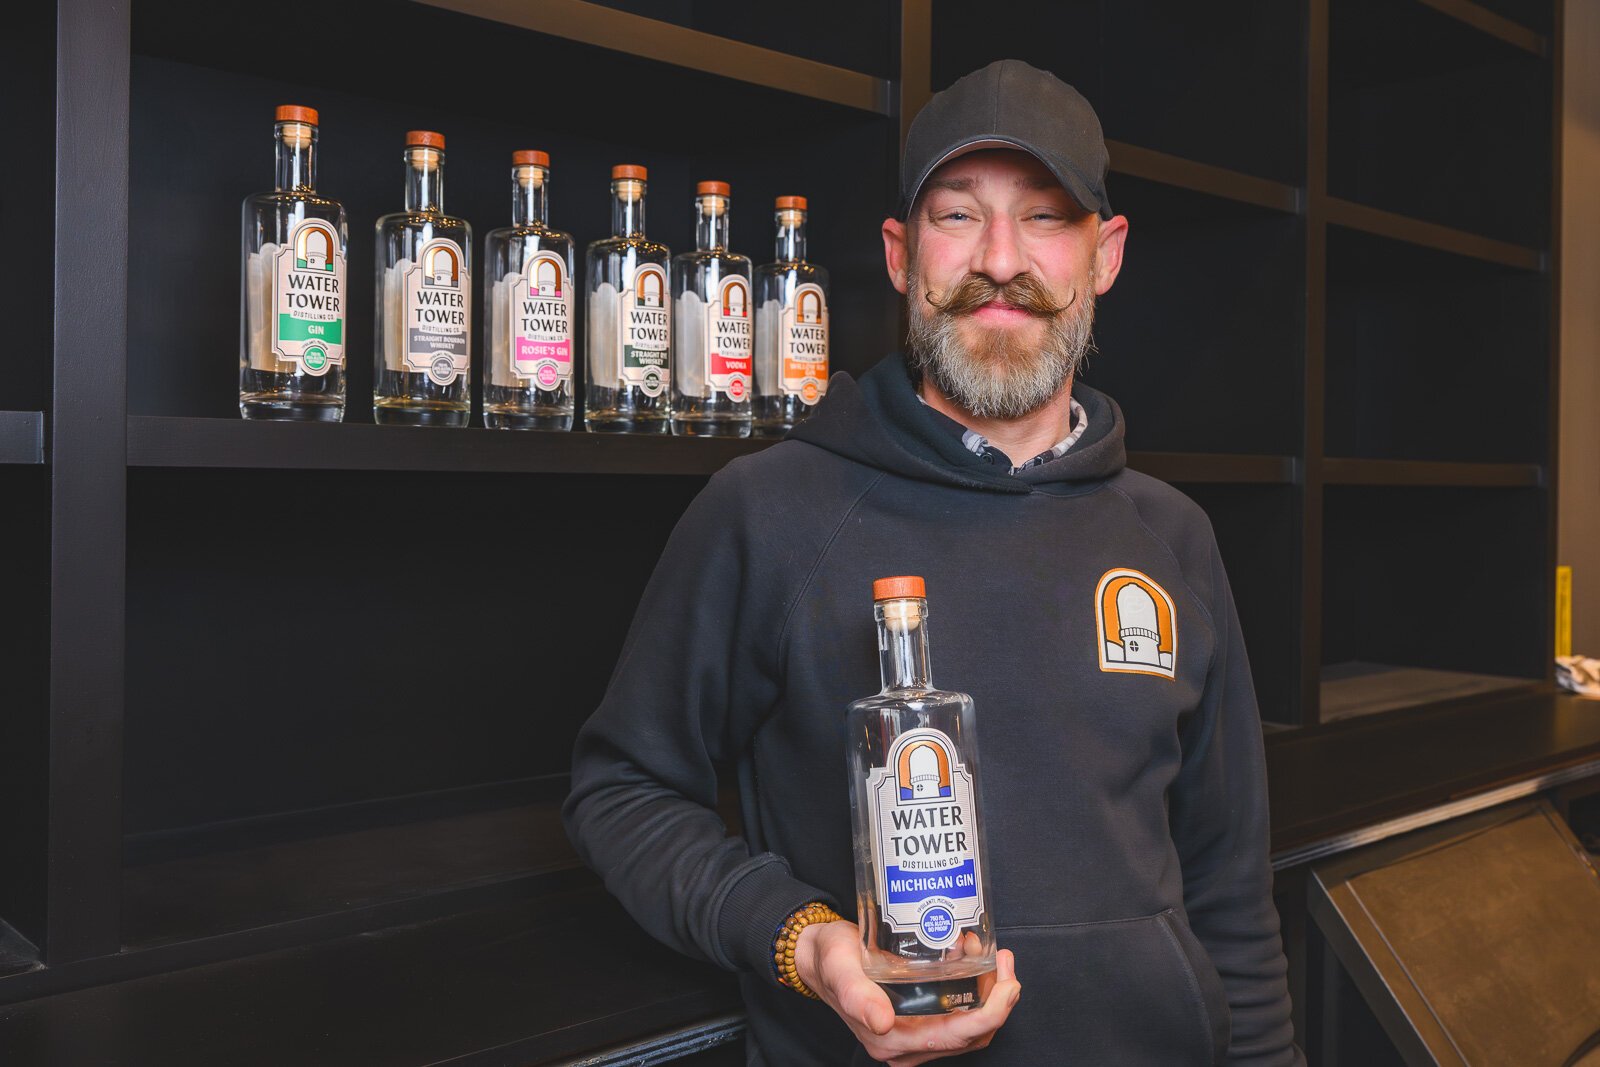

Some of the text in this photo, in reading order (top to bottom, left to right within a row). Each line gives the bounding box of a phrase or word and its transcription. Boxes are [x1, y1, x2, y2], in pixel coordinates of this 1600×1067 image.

[288, 274, 339, 293] WATER
[285, 293, 340, 312] TOWER
[417, 291, 464, 308] WATER
[293, 310, 326, 319] DISTILLING
[523, 301, 567, 317] WATER
[415, 308, 465, 325] TOWER
[630, 311, 668, 326] WATER
[308, 325, 324, 335] GIN
[422, 325, 452, 333] DISTILLING
[521, 318, 568, 333] TOWER
[717, 321, 751, 335] WATER
[628, 327, 668, 342] TOWER
[790, 328, 826, 341] WATER
[715, 336, 751, 350] TOWER
[789, 342, 827, 355] TOWER
[521, 345, 568, 356] ROSIE'S GIN
[630, 350, 659, 359] STRAIGHT
[638, 358, 664, 366] WHISKEY
[725, 361, 747, 370] VODKA
[891, 805, 964, 831] WATER
[891, 831, 968, 857] TOWER
[902, 859, 947, 869] DISTILLING
[890, 873, 974, 893] MICHIGAN GIN
